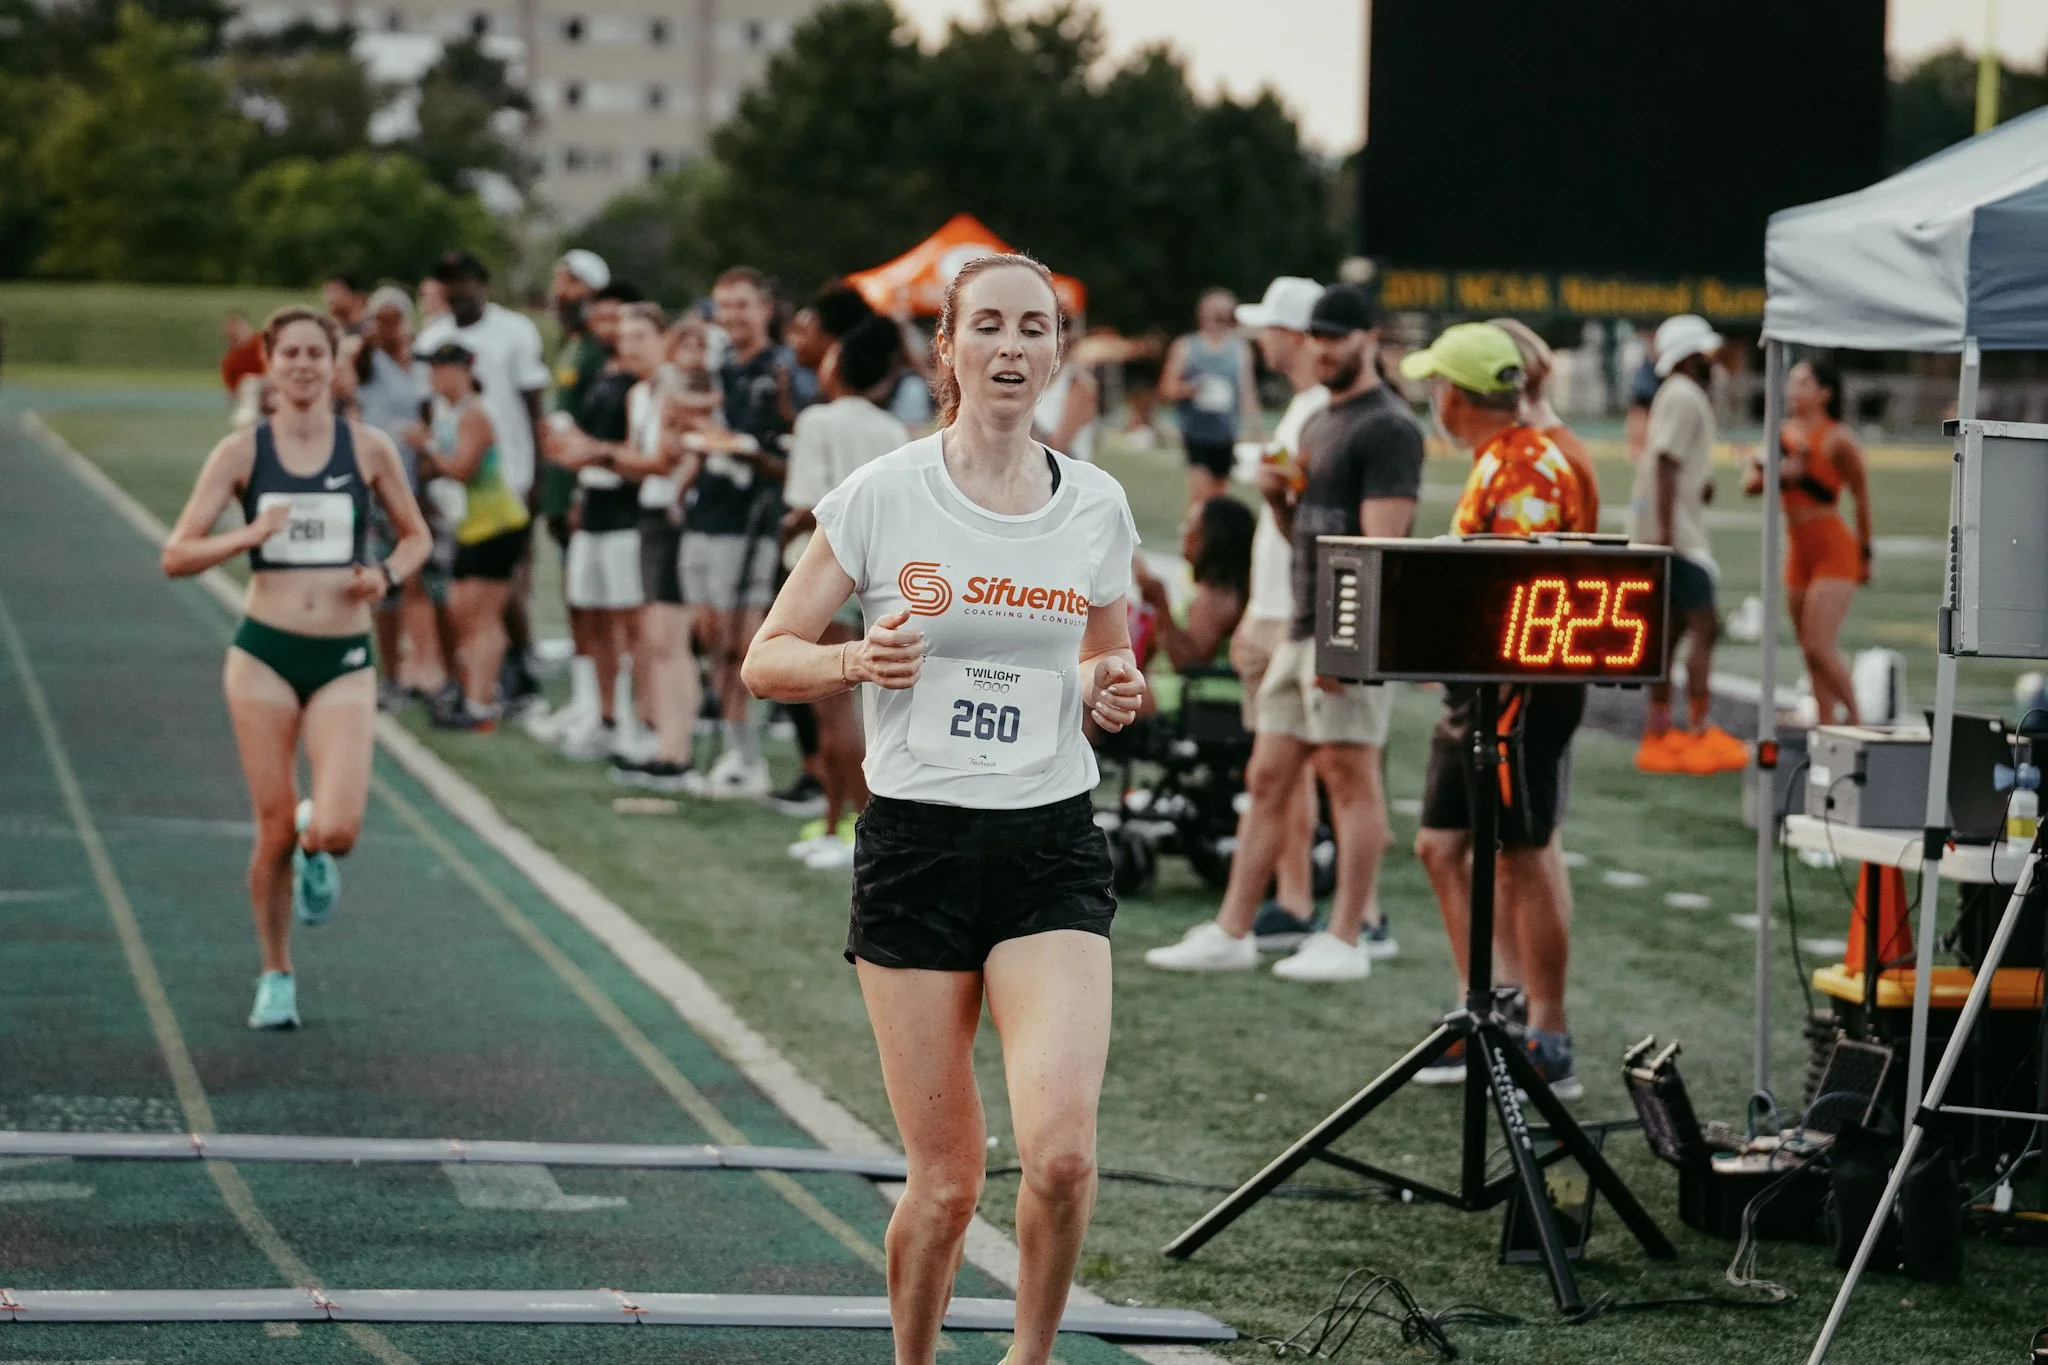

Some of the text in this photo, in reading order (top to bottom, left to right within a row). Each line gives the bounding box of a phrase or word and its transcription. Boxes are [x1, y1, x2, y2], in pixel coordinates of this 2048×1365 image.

[290, 519, 324, 541] 261
[962, 576, 1089, 617] Sifuente
[963, 608, 1023, 619] COACHING
[1503, 579, 1651, 665] 18:25
[965, 667, 1021, 684] TWILIGHT
[973, 680, 1011, 694] 5000
[950, 699, 1021, 744] 260
